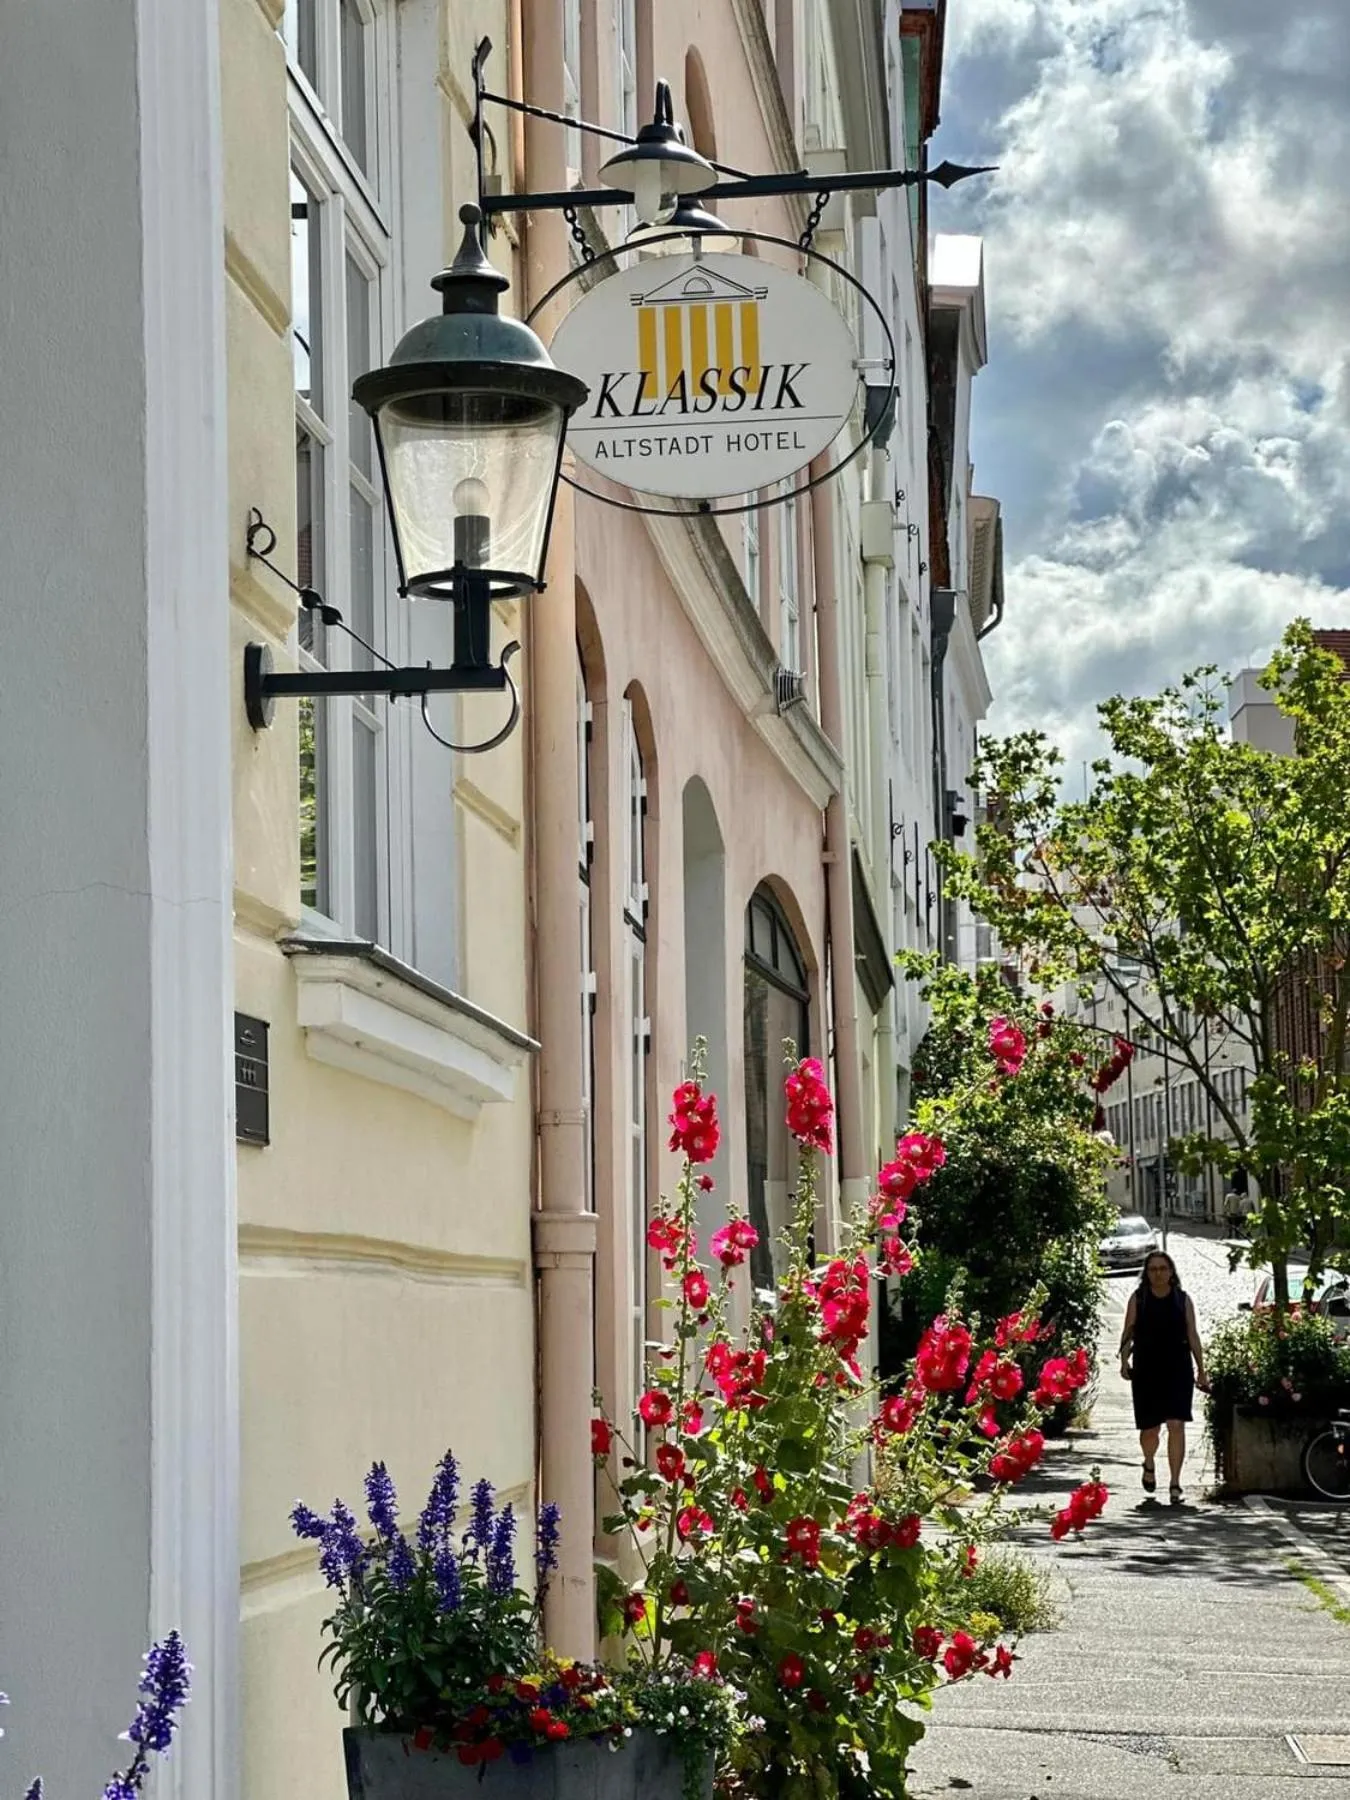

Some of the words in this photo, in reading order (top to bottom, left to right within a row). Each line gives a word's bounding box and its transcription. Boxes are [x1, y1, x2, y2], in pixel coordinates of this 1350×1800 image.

[591, 363, 810, 419] KLASSIK
[595, 435, 713, 459] ALTSTADT
[727, 431, 806, 453] HOTEL
